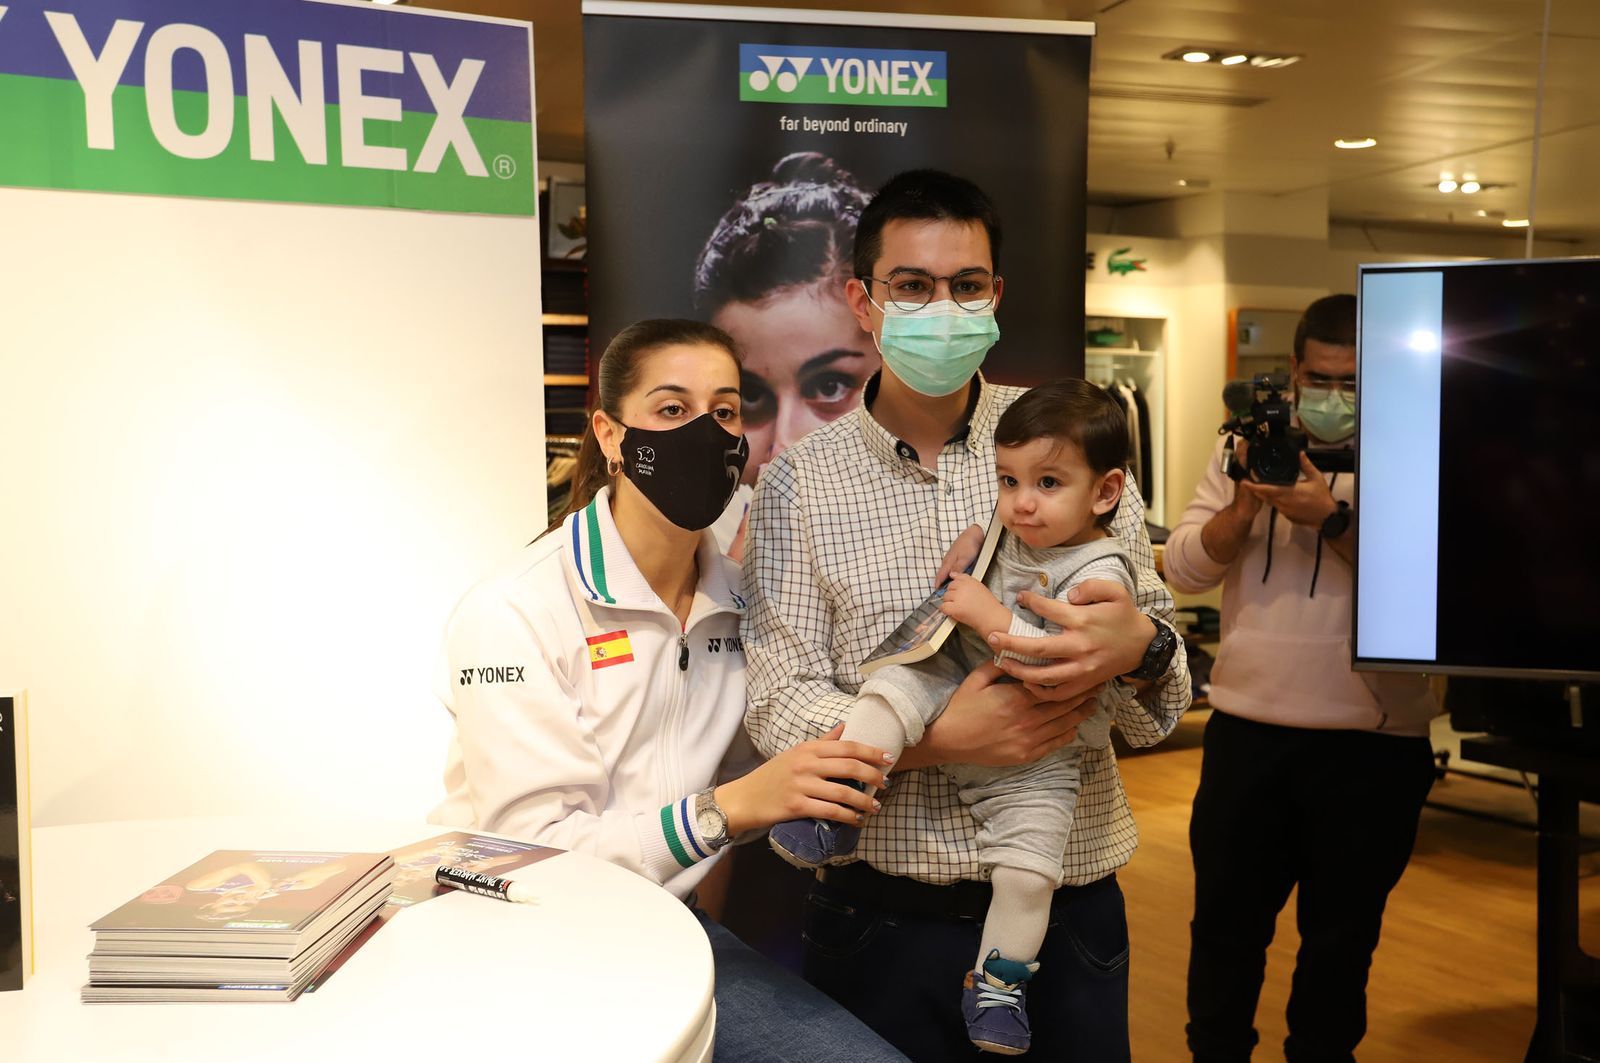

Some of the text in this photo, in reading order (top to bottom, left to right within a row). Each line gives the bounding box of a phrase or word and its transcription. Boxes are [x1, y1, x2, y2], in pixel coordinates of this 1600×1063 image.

[820, 57, 934, 97] YONEX
[780, 116, 908, 137] far beyond ordinary
[723, 637, 744, 652] YONE
[477, 666, 525, 684] YONEX
